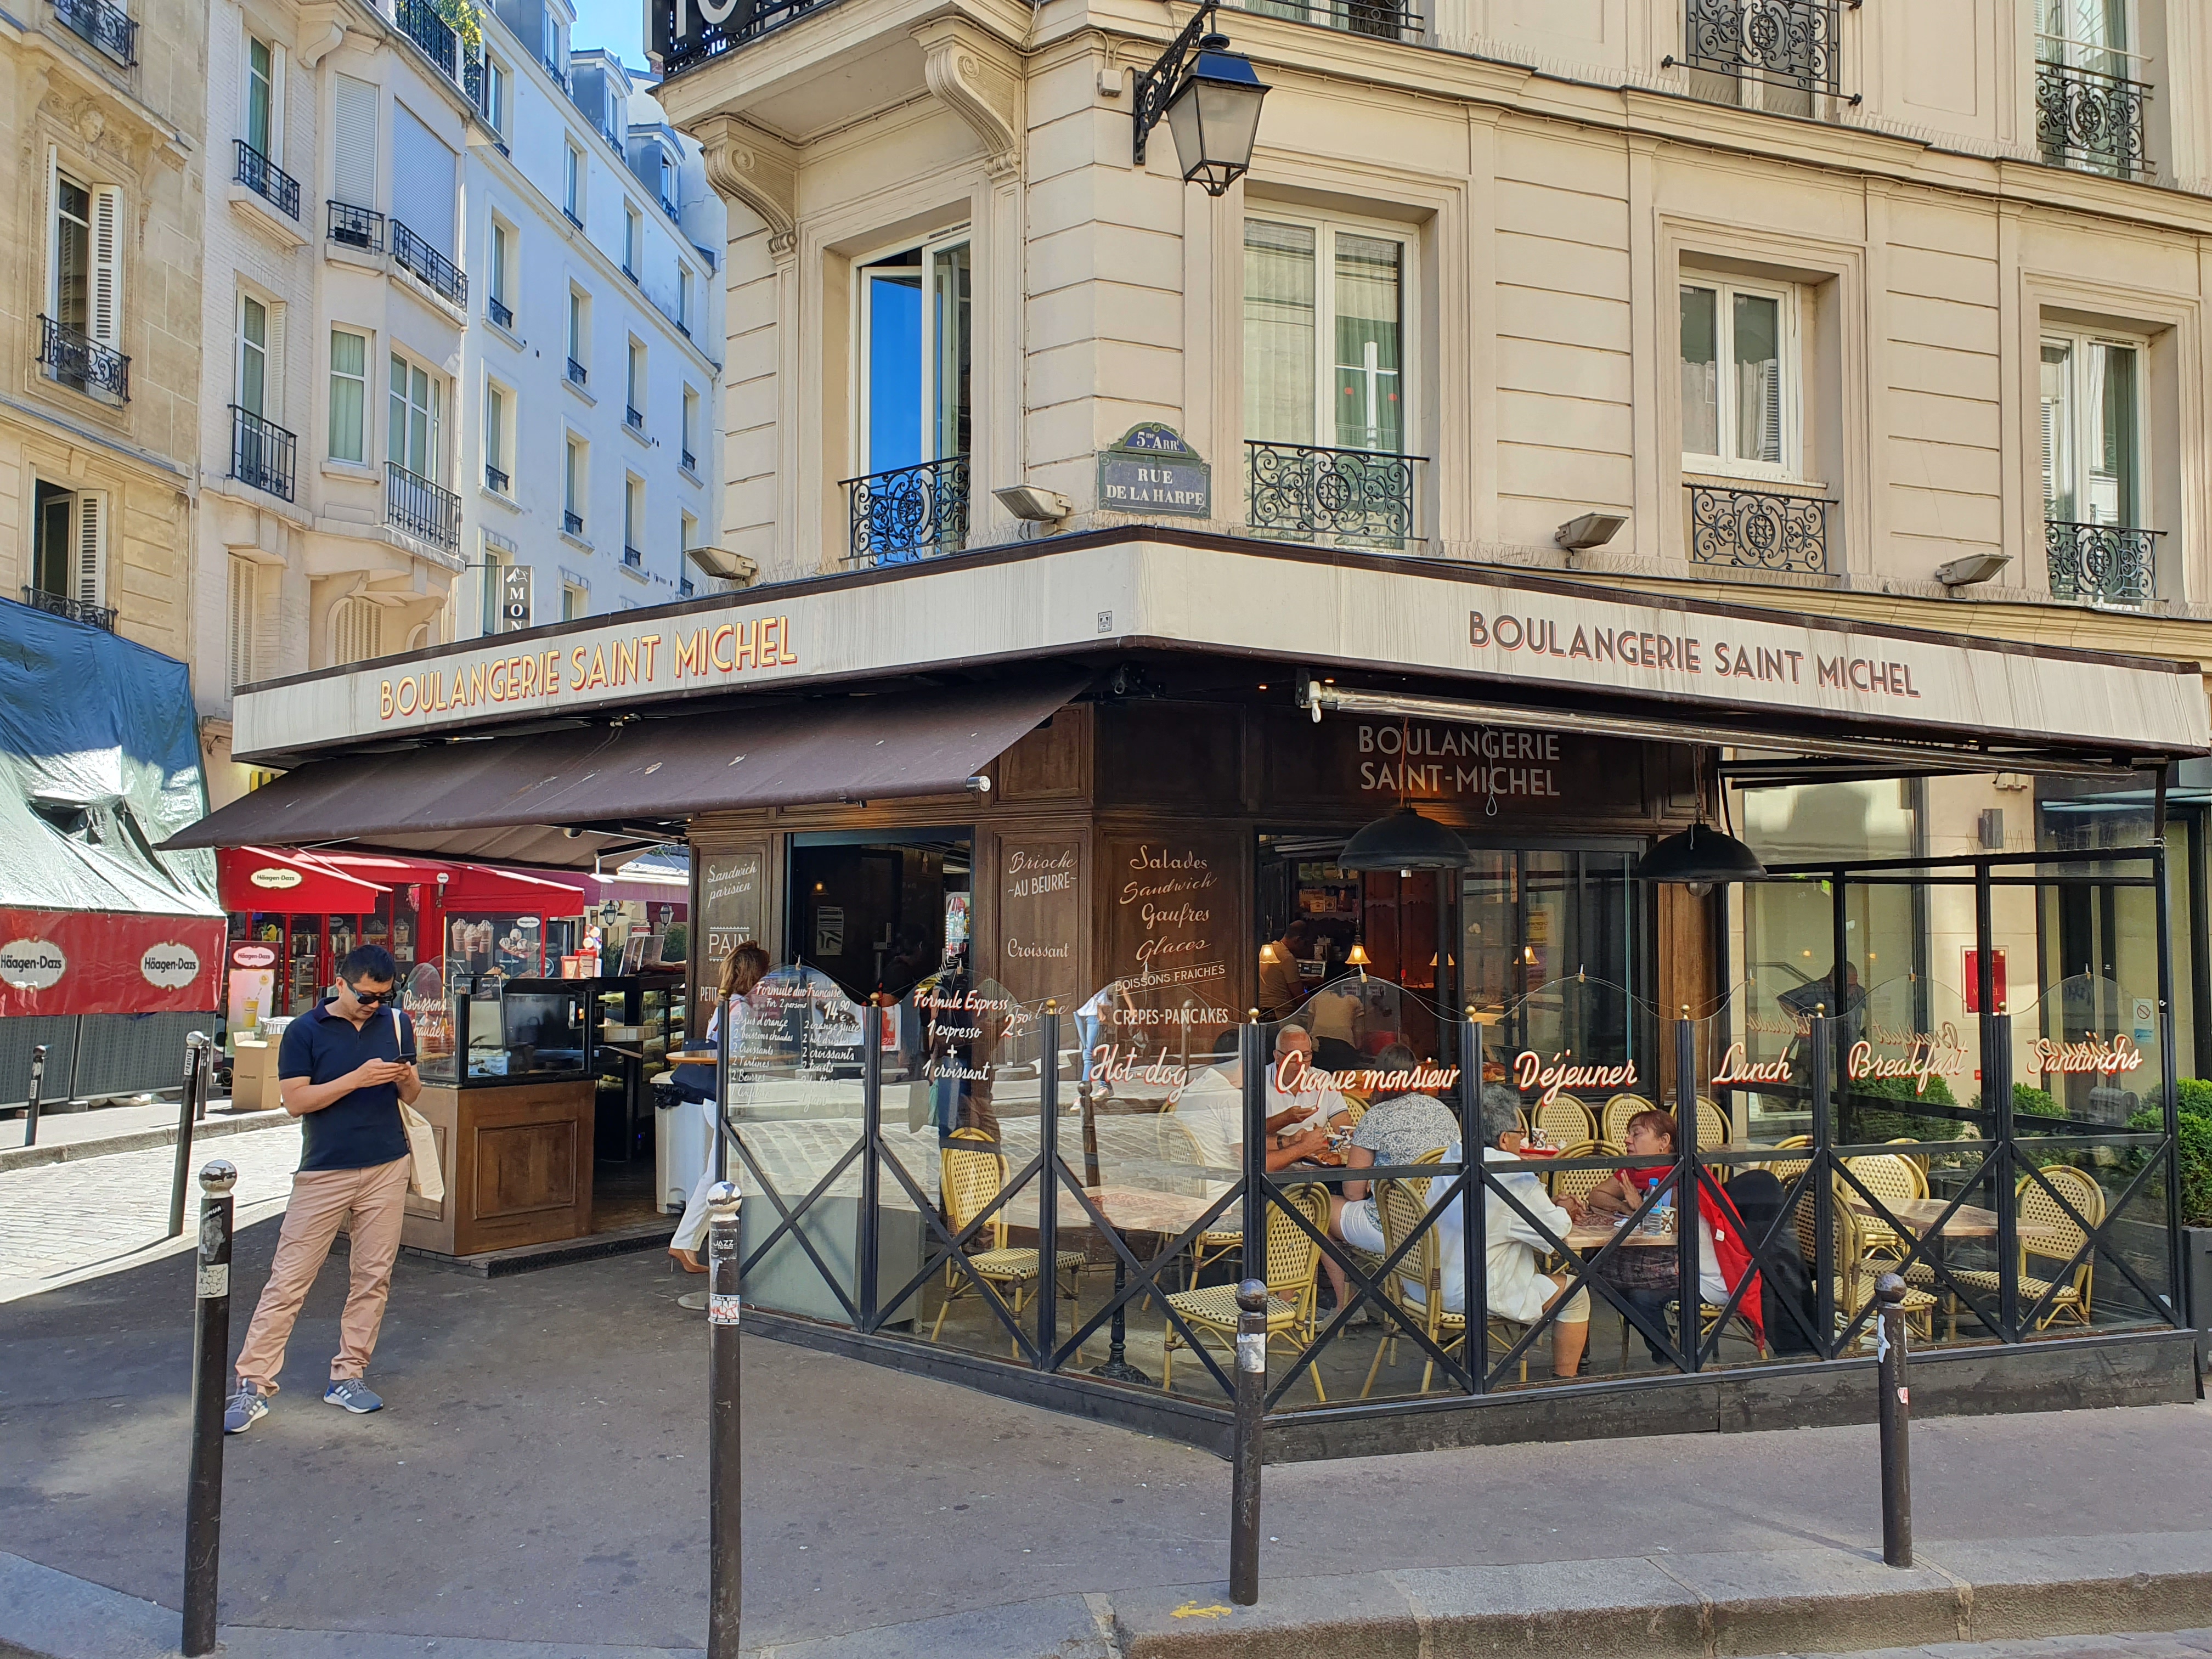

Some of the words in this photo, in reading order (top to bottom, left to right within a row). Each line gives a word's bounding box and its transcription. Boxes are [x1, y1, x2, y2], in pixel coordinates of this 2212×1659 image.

[1137, 468, 1173, 484] RUE
[1106, 485, 1127, 499] DE
[1130, 487, 1150, 501] LA
[1153, 489, 1205, 506] HARPE
[1469, 610, 1701, 674] BOULANGERIE
[1715, 641, 1804, 685] SAINT
[1816, 653, 1921, 698] MICHEL
[380, 649, 561, 720] BOULANGERIE
[570, 634, 661, 691] SAINT
[674, 615, 798, 678] MICHEL
[1358, 725, 1560, 760] BOULANGERIE
[1360, 761, 1561, 796] SAINT-MICHEL
[1008, 850, 1077, 874] Brioche
[1130, 845, 1207, 870] Salades
[257, 874, 295, 882] Häagen-Dazs
[707, 861, 757, 883] Sandwich
[1031, 871, 1070, 895] BEURRE
[708, 882, 752, 909] parisien
[1119, 871, 1218, 905] Sandwich
[1142, 902, 1209, 930] Gaufres
[1008, 938, 1070, 958] Croissant
[1136, 935, 1211, 967] Glaces
[0, 953, 62, 973] Häagen-Dazs
[144, 957, 196, 973] Häagen-Dazs
[756, 978, 793, 997] Formule
[793, 983, 808, 997] duo
[808, 981, 843, 1000] Française
[1115, 971, 1171, 992] BOISSONS
[1175, 964, 1226, 982] FRAICHES
[403, 989, 447, 1012] Boissons
[766, 998, 777, 1008] For
[779, 998, 784, 1008] 2
[784, 1001, 808, 1014] persons
[913, 988, 963, 1010] Formule
[964, 989, 1008, 1017] Express
[741, 1013, 755, 1030] jus
[758, 1012, 789, 1032] d'orange
[804, 1020, 809, 1029] 2
[810, 1022, 838, 1036] orange
[838, 1021, 861, 1037] juice
[927, 1019, 936, 1035] 1
[935, 1024, 983, 1043] expresso
[733, 1028, 739, 1039] 2
[741, 1028, 769, 1041] boissons
[769, 1030, 793, 1042] chaudes
[802, 1034, 808, 1043] 2
[810, 1033, 822, 1043] hot
[732, 1042, 738, 1053] 2
[739, 1042, 774, 1056] Croissants
[802, 1047, 808, 1057] 2
[809, 1046, 855, 1060] croissants
[2027, 1037, 2143, 1074] Sandwichs
[732, 1055, 737, 1066] 2
[739, 1056, 770, 1069] Tartines
[809, 1060, 835, 1074] toasts
[922, 1059, 932, 1076] 1
[934, 1061, 991, 1081] croissant
[1711, 1041, 1793, 1085] Lunch
[1848, 1040, 1968, 1096] Breakfast
[731, 1070, 737, 1081] 2
[1088, 1043, 1197, 1105] Hot-dog
[1275, 1049, 1357, 1113] Croque
[1361, 1057, 1461, 1092] monsieur
[1513, 1048, 1639, 1107] Déjeuner
